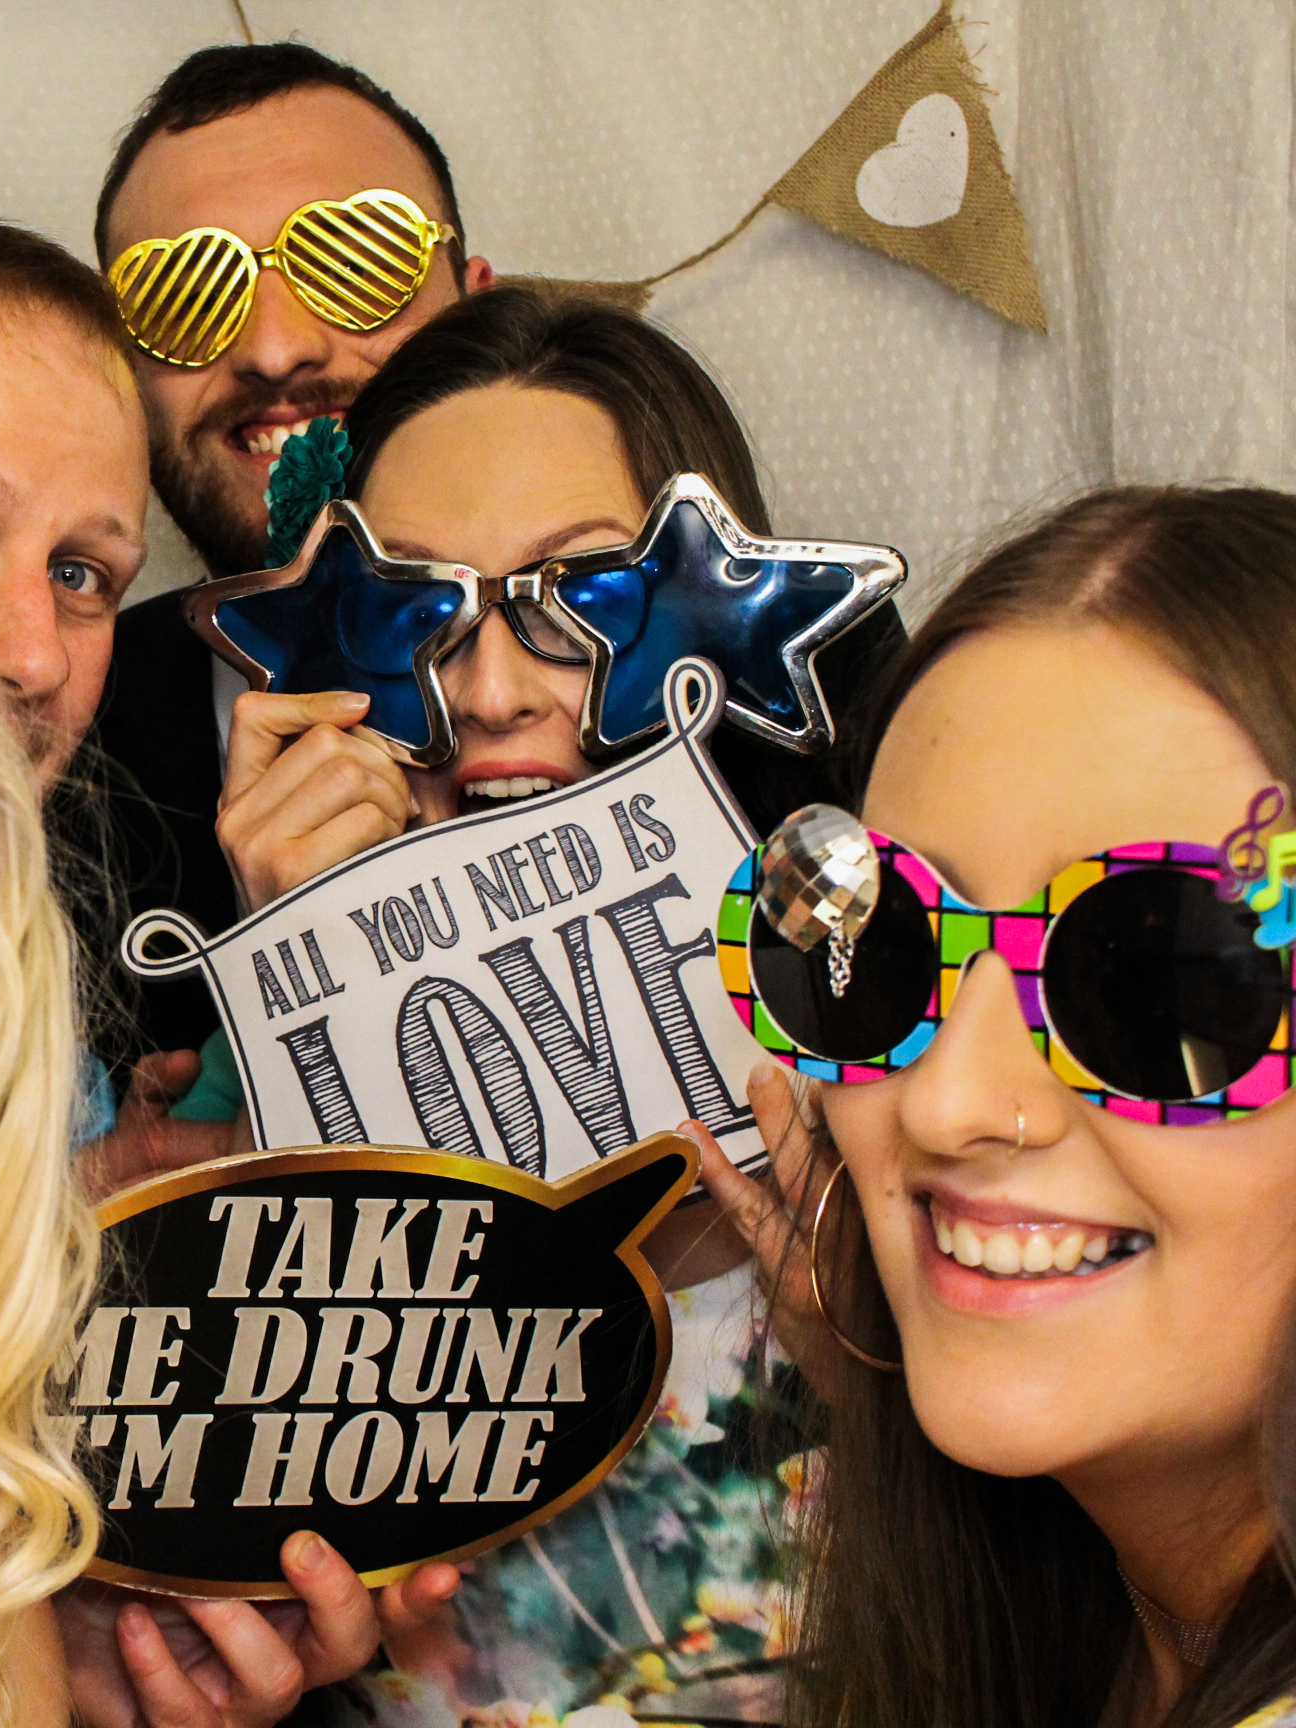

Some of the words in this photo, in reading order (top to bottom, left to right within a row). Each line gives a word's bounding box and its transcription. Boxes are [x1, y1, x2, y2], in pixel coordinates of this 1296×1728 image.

[251, 929, 346, 1020] ALL
[347, 877, 460, 977] YOU
[464, 823, 602, 933] NEED
[608, 793, 677, 873] IS
[207, 1196, 494, 1300] TAKE
[214, 1306, 603, 1406] DRUNK
[233, 1410, 555, 1507] HOME
